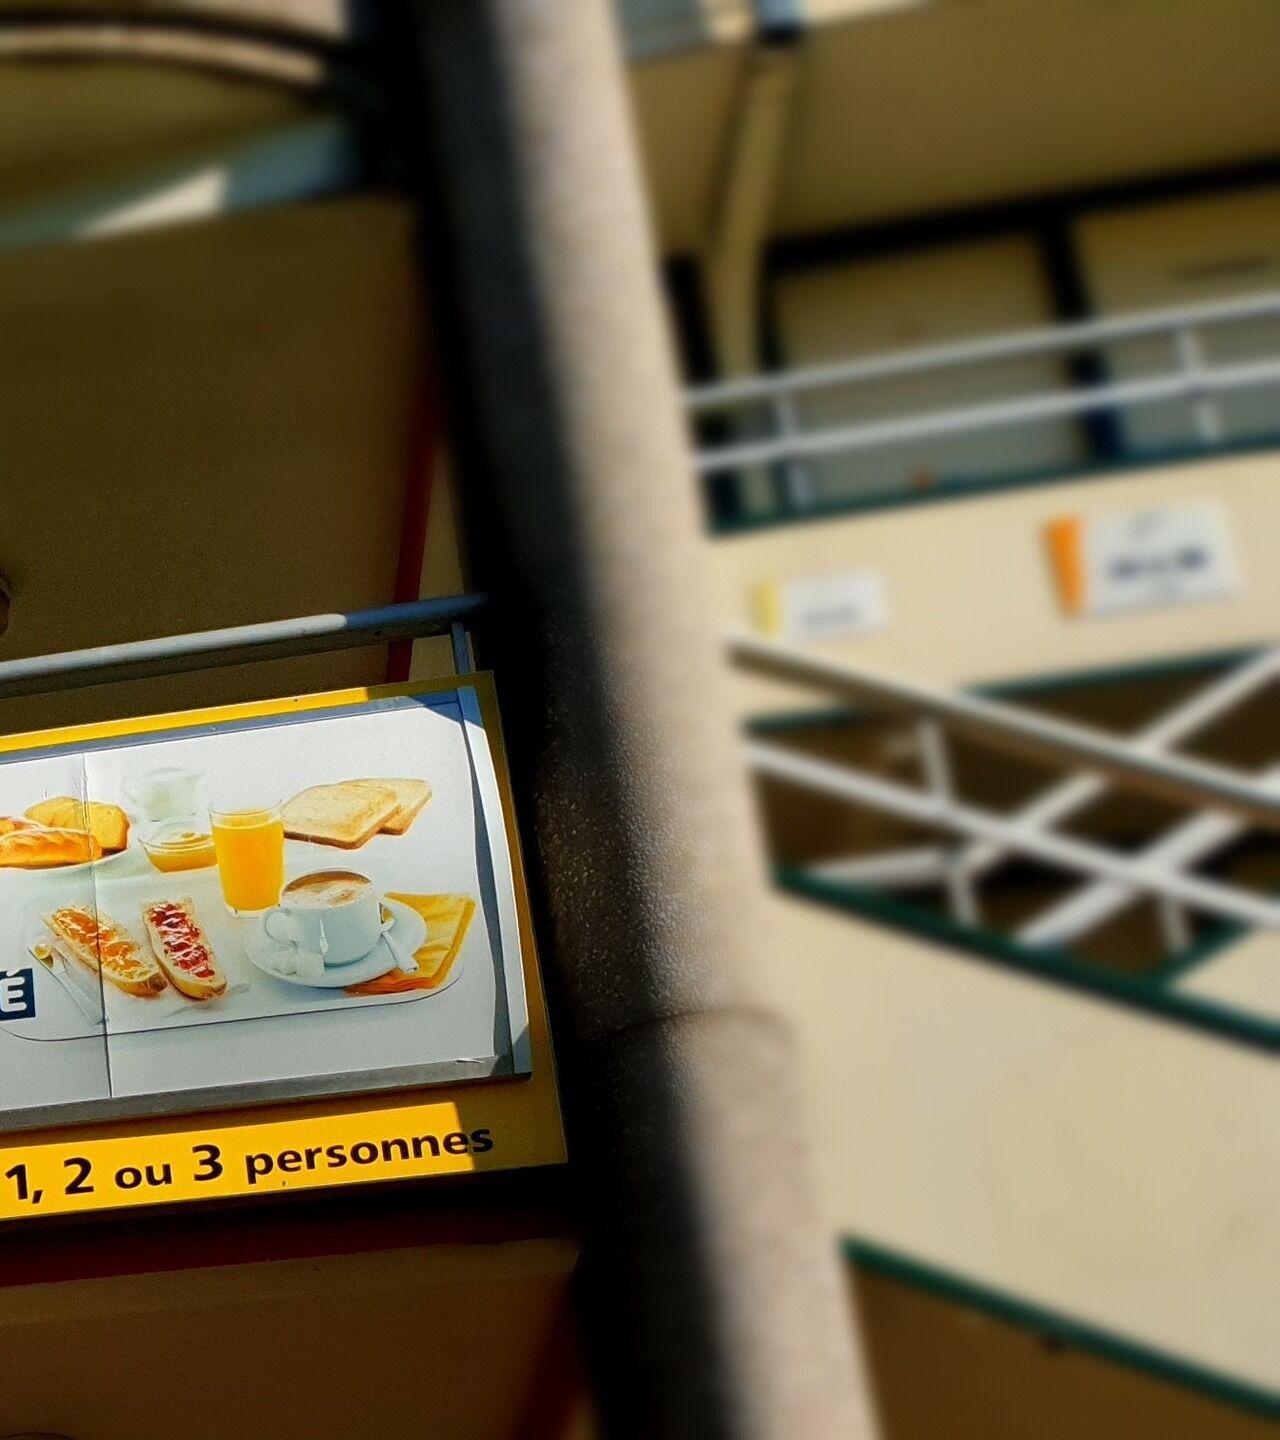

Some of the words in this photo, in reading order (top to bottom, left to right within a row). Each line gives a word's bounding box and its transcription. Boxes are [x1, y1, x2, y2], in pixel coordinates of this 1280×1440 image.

[4, 1163, 44, 1205] 1,
[63, 1156, 95, 1195] 2
[113, 1162, 173, 1190] ou
[191, 1143, 223, 1182] 3
[244, 1127, 494, 1185] personnes
